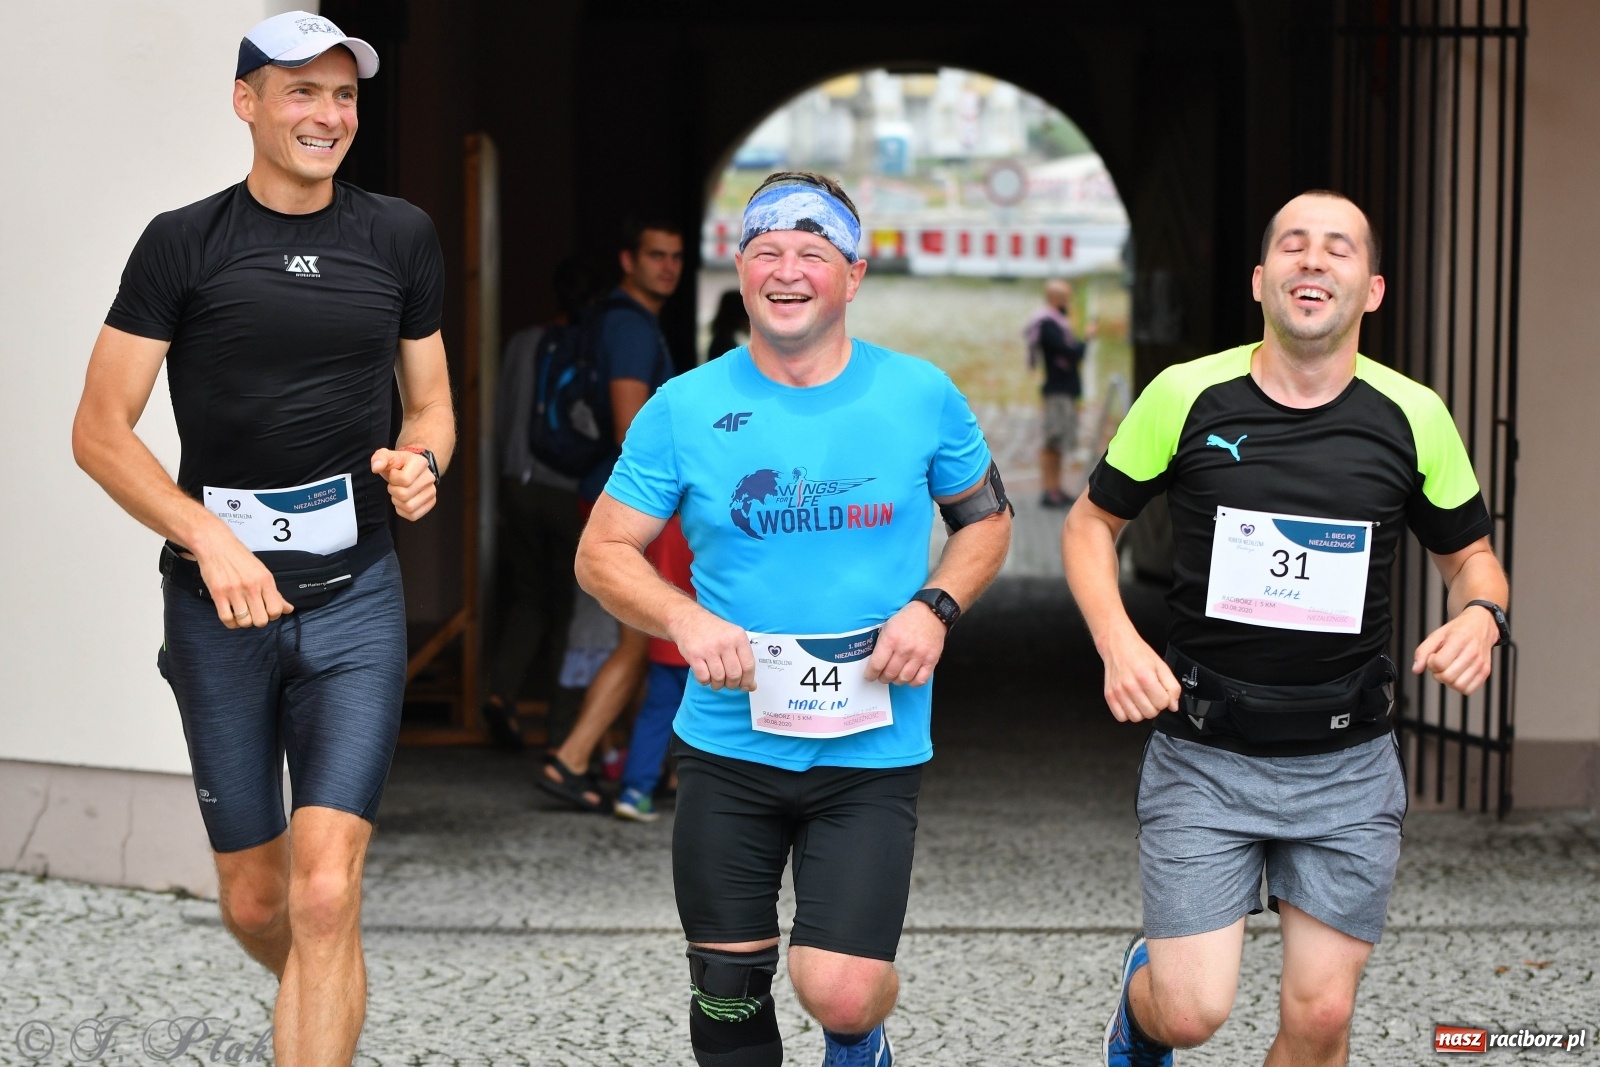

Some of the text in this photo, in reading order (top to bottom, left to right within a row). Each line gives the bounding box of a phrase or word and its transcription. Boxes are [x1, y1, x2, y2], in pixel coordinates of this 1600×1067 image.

[712, 412, 753, 432] 4F
[313, 489, 327, 499] BIEG
[327, 487, 336, 496] PO
[778, 480, 838, 497] WINGS
[757, 502, 894, 535] WORLD RUN
[272, 517, 292, 543] 3
[1308, 539, 1355, 549] NIEZALEŻNOŚĆ
[1269, 549, 1310, 581] 31
[1263, 585, 1301, 600] RAFAŁ
[1221, 595, 1253, 606] RACIBÓRZ
[1221, 603, 1253, 614] 30.08.2020
[799, 665, 842, 693] 44
[787, 697, 849, 711] MARCIN
[762, 710, 791, 720] RACIBÓRZ
[763, 718, 792, 727] 30.08.2020
